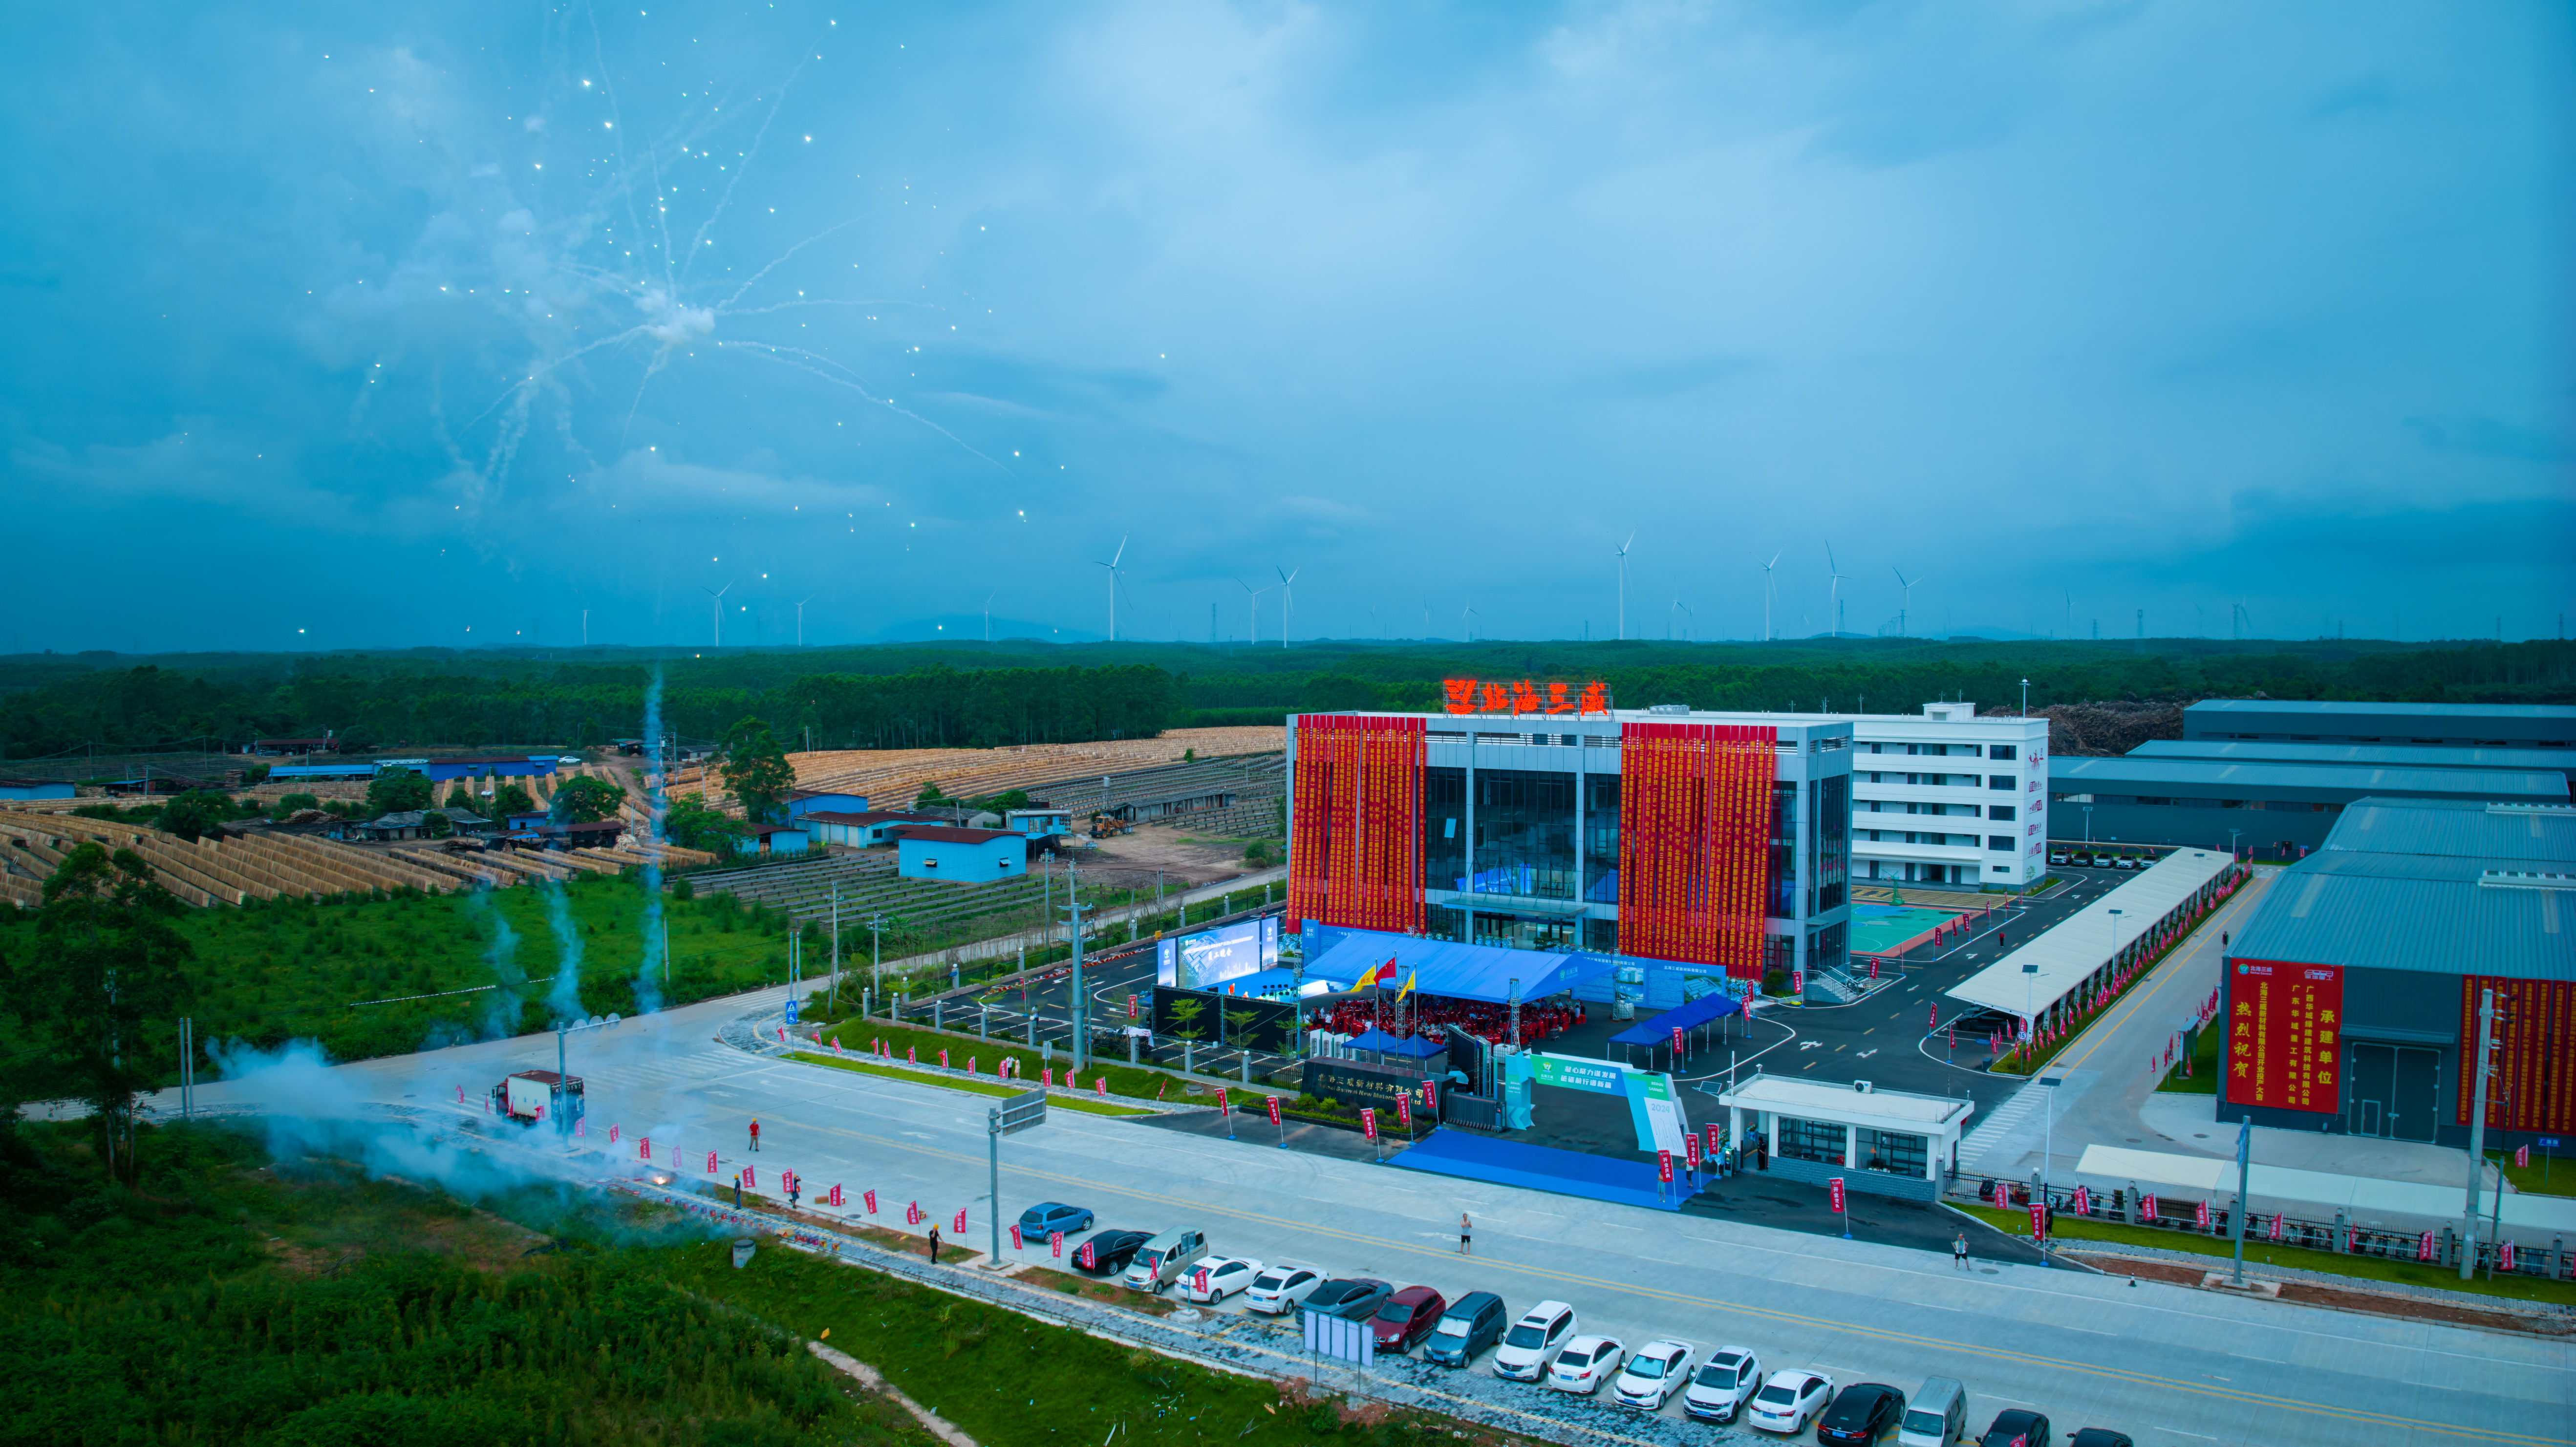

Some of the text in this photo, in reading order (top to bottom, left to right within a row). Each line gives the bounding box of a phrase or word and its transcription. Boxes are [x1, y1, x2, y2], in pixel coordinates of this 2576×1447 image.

[1479, 680, 1608, 717] 北海三威
[2233, 1001, 2252, 1078] 热烈祝贺
[2255, 981, 2268, 1102] 北海三威新材料有限公司开业投产大吉
[2288, 984, 2300, 1105] 广东华域重工有限公司
[2301, 985, 2315, 1106] 广西华域绿建建筑科技有限公司
[2318, 1010, 2335, 1085] 承建单位
[1318, 1073, 1424, 1099] 北海三威新材料有限公司
[1561, 1075, 1611, 1089] 砥砺前行谱新篇
[1564, 1065, 1616, 1080] 凝心聚力谋发展
[1373, 1092, 1397, 1101] Materia
[1651, 1103, 1670, 1113] 2024
